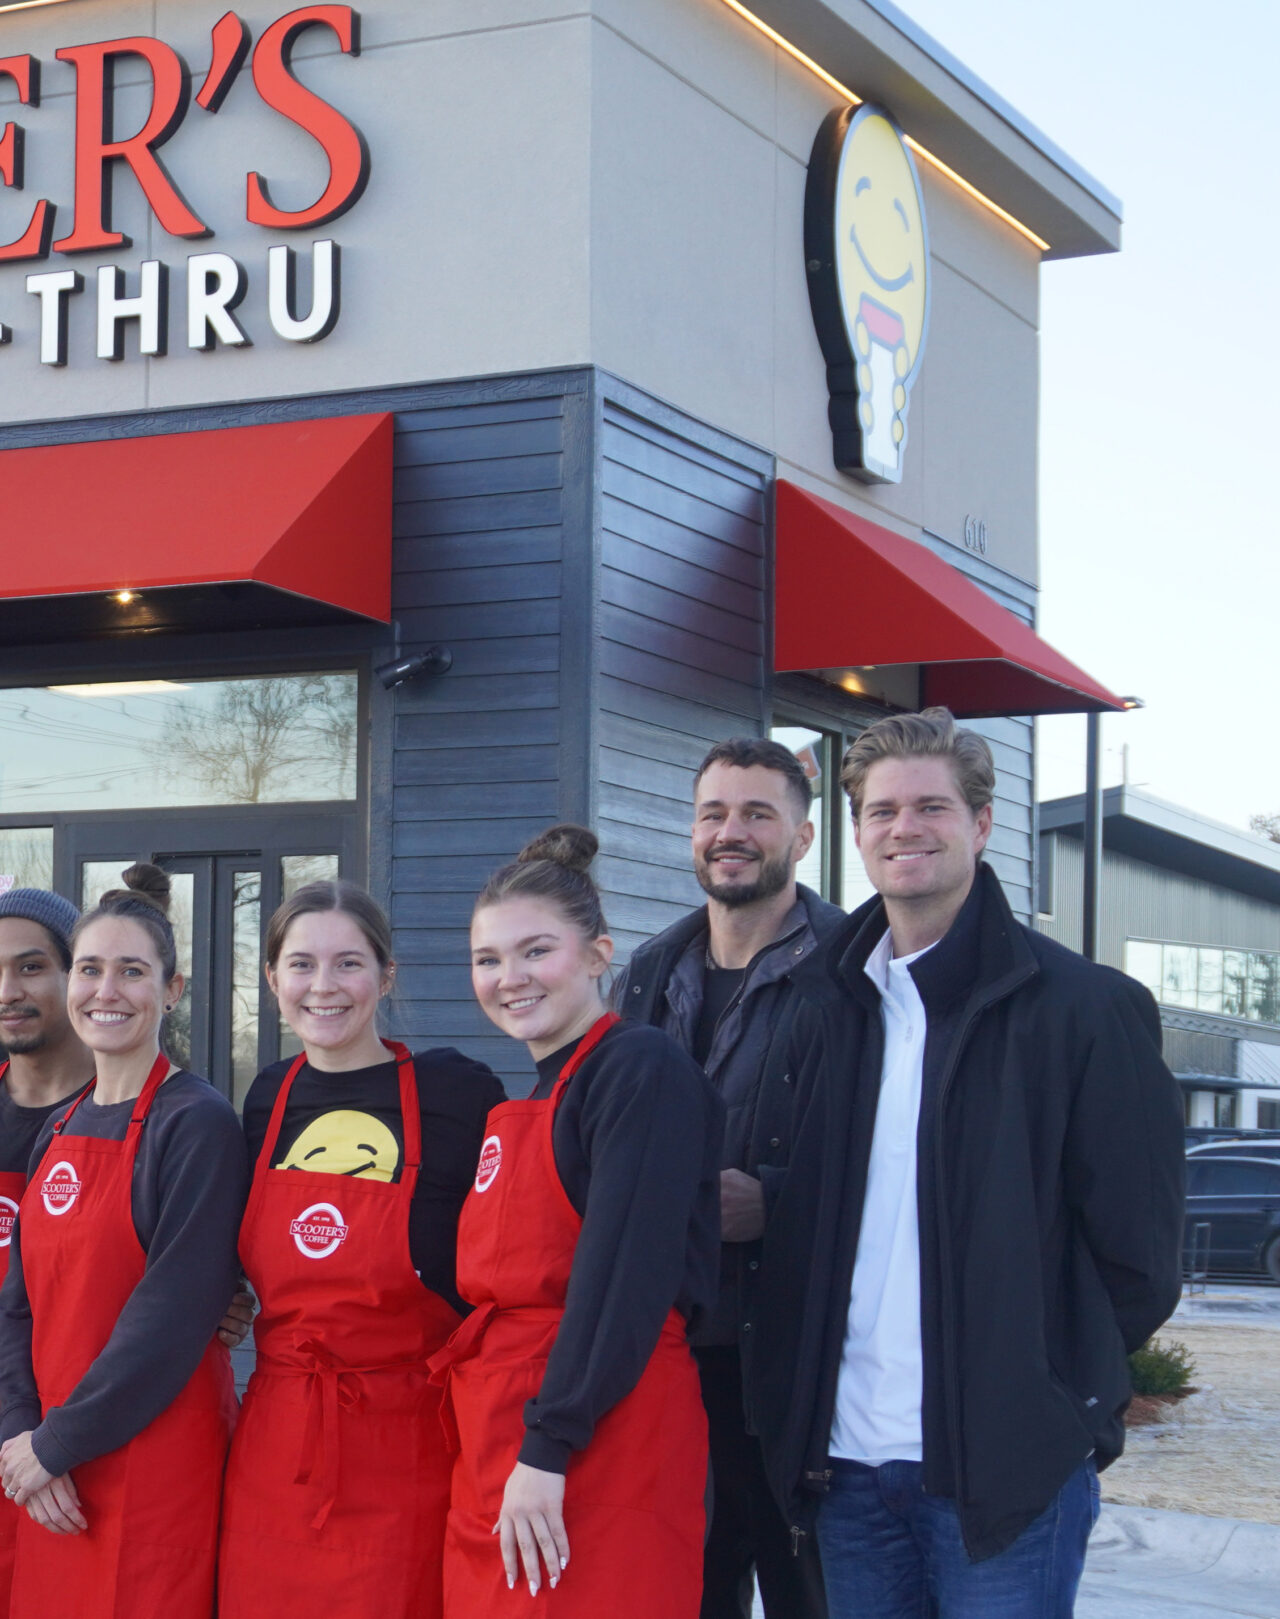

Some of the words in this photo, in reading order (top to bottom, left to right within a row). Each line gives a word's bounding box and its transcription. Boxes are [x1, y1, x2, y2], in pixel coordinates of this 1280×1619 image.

[42, 1183, 79, 1194] SCOOTER'S
[292, 1221, 345, 1238] SCOOTER'S
[304, 1234, 329, 1244] COFFEE
